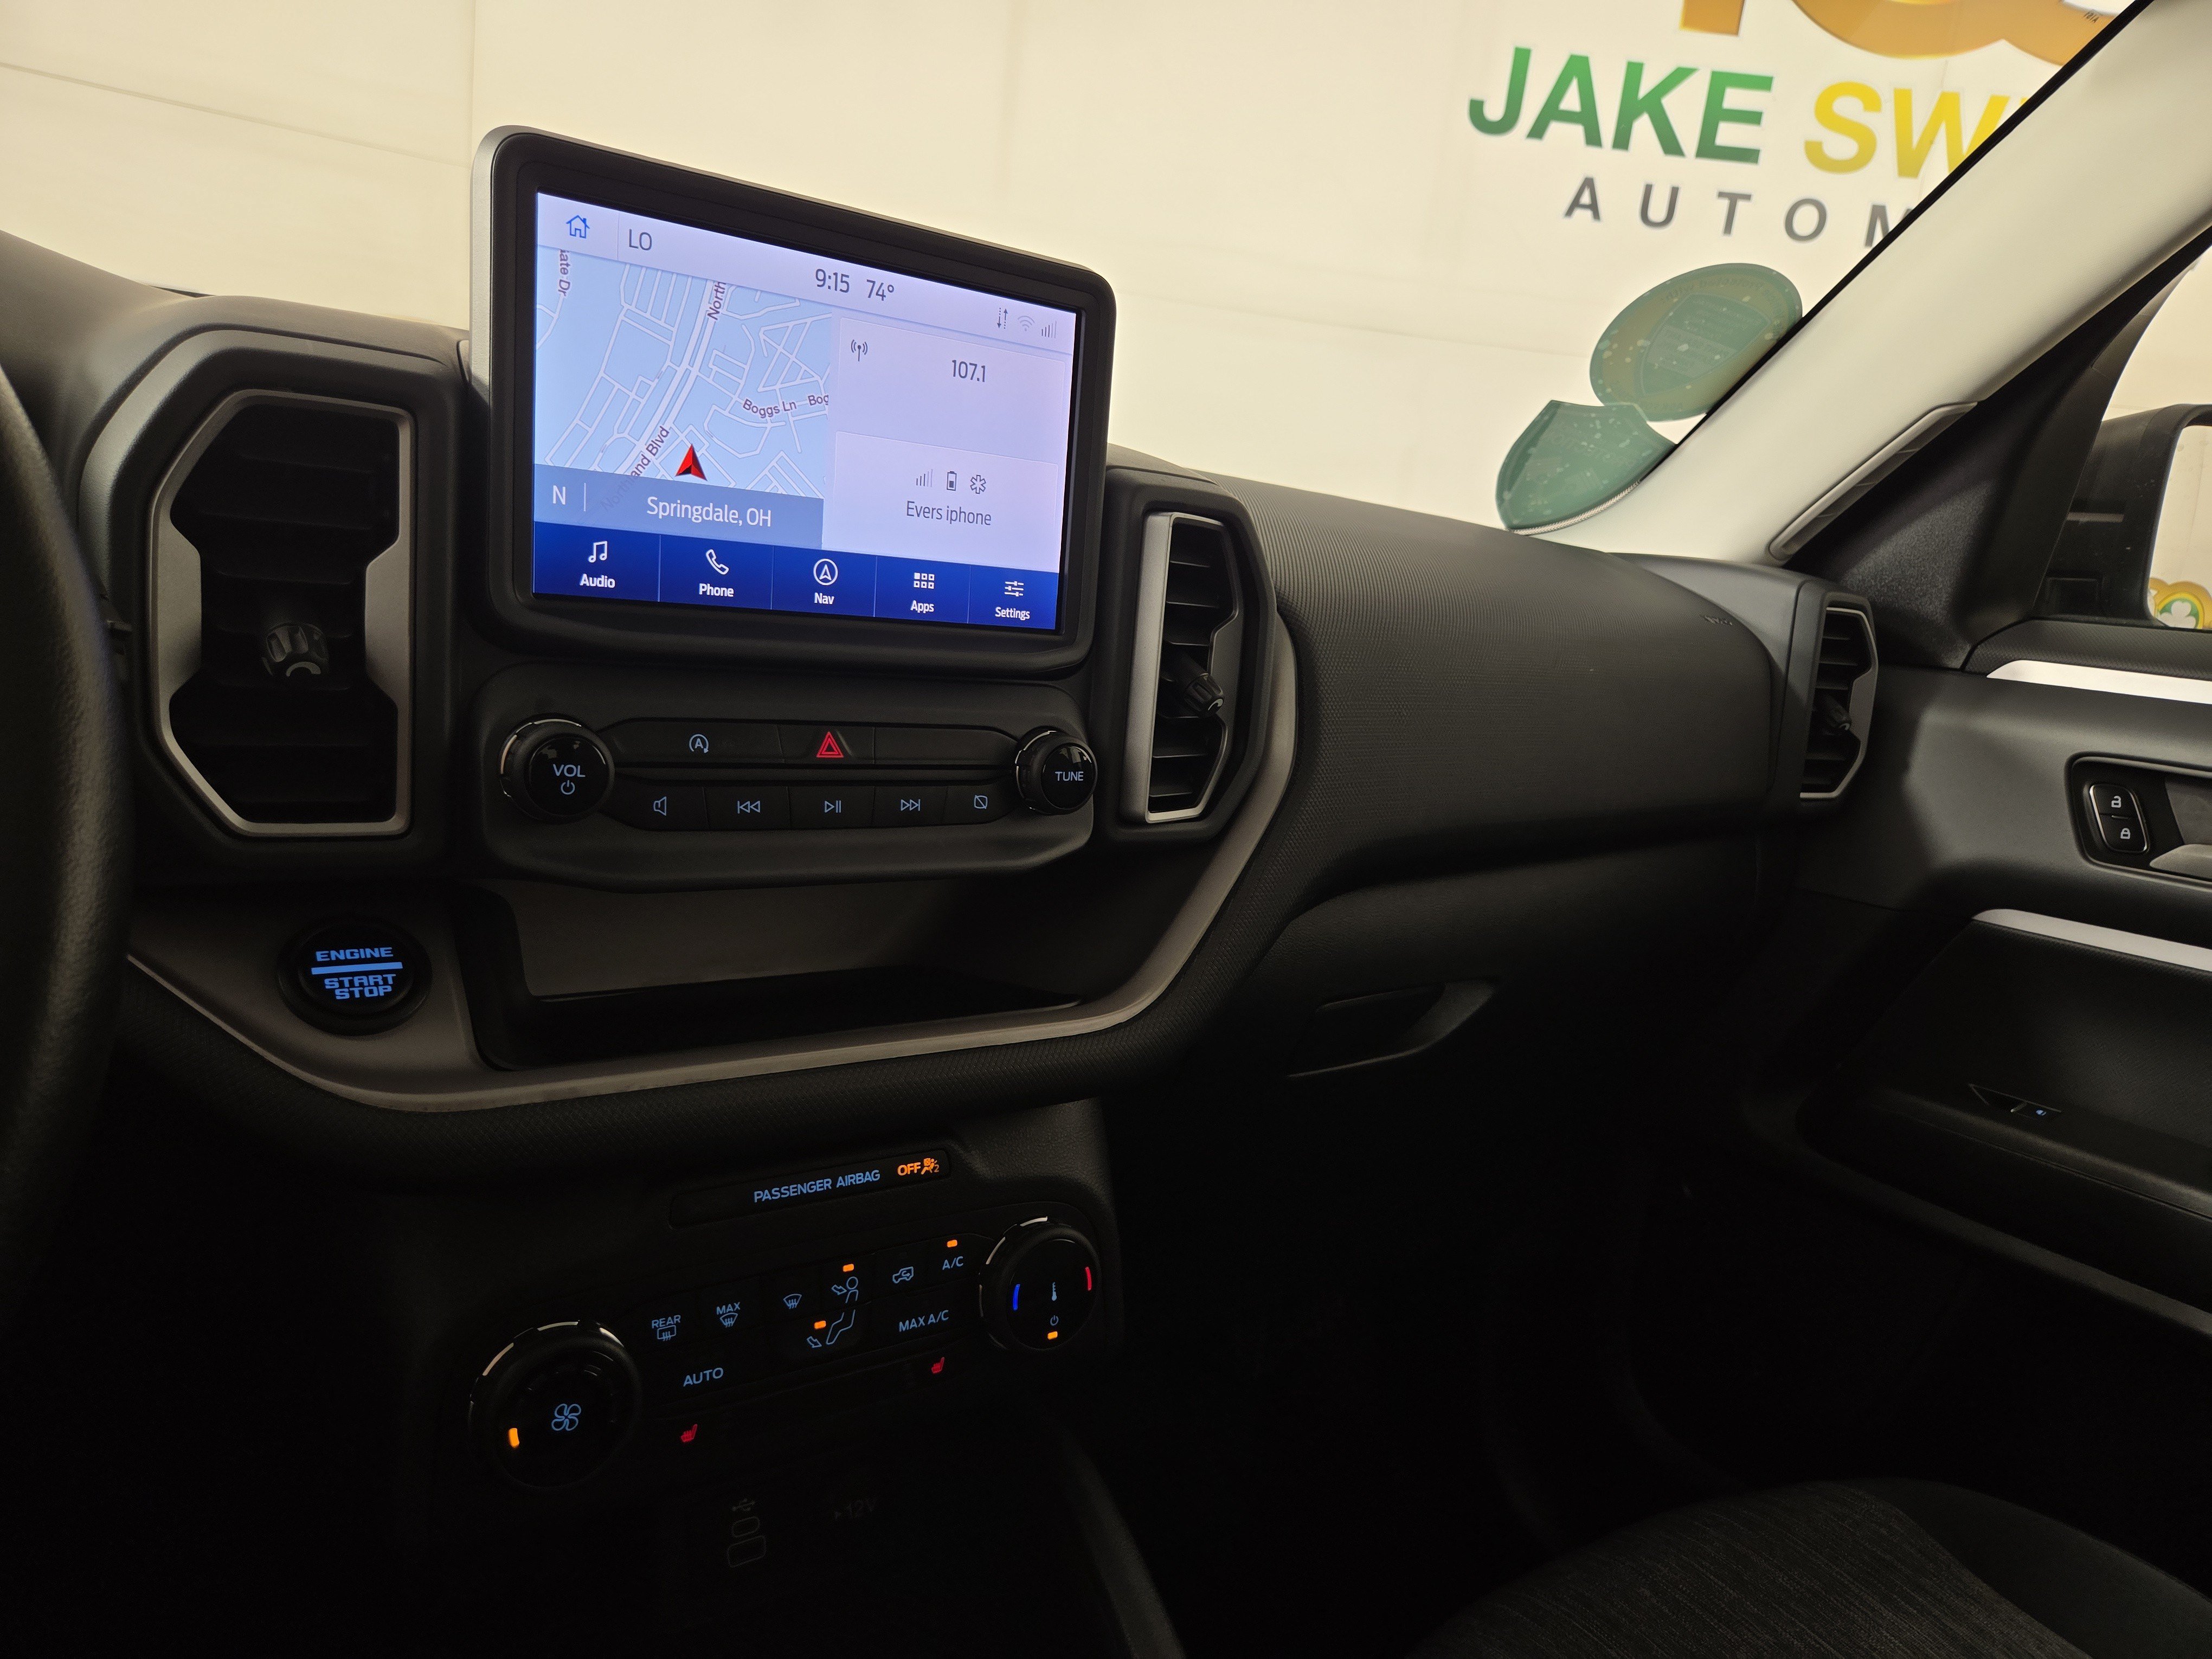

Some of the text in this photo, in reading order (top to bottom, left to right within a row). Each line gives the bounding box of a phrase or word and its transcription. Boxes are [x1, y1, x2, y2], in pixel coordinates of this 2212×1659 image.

[1468, 46, 2030, 179] JAKE SW
[628, 228, 653, 251] LO
[558, 279, 571, 297] Dr
[815, 268, 895, 301] 9:15 74°
[707, 281, 726, 320] North
[951, 359, 986, 383] 107.1
[742, 398, 796, 419] Boggs Ln
[646, 426, 670, 459] Blvd
[552, 485, 567, 505] N
[647, 496, 772, 528] Springdale, OH
[906, 500, 992, 526] Evers iphone
[579, 573, 616, 589] Audio
[698, 583, 734, 597] Phone
[814, 593, 835, 605] Nav
[910, 600, 935, 614] Apps
[995, 607, 1030, 621] Settings
[553, 764, 586, 778] VOL
[1055, 771, 1084, 782] TUNE
[315, 947, 394, 962] ENGINE
[324, 974, 396, 989] START
[335, 985, 392, 1000] STOP
[897, 1162, 921, 1176] OFF
[754, 1169, 880, 1203] PASSENGER AIRBAG
[942, 1256, 964, 1270] A/C
[716, 1302, 741, 1315] MAX
[652, 1315, 681, 1328] REAR
[899, 1309, 949, 1332] MAX A/C
[683, 1367, 724, 1387] AUTO
